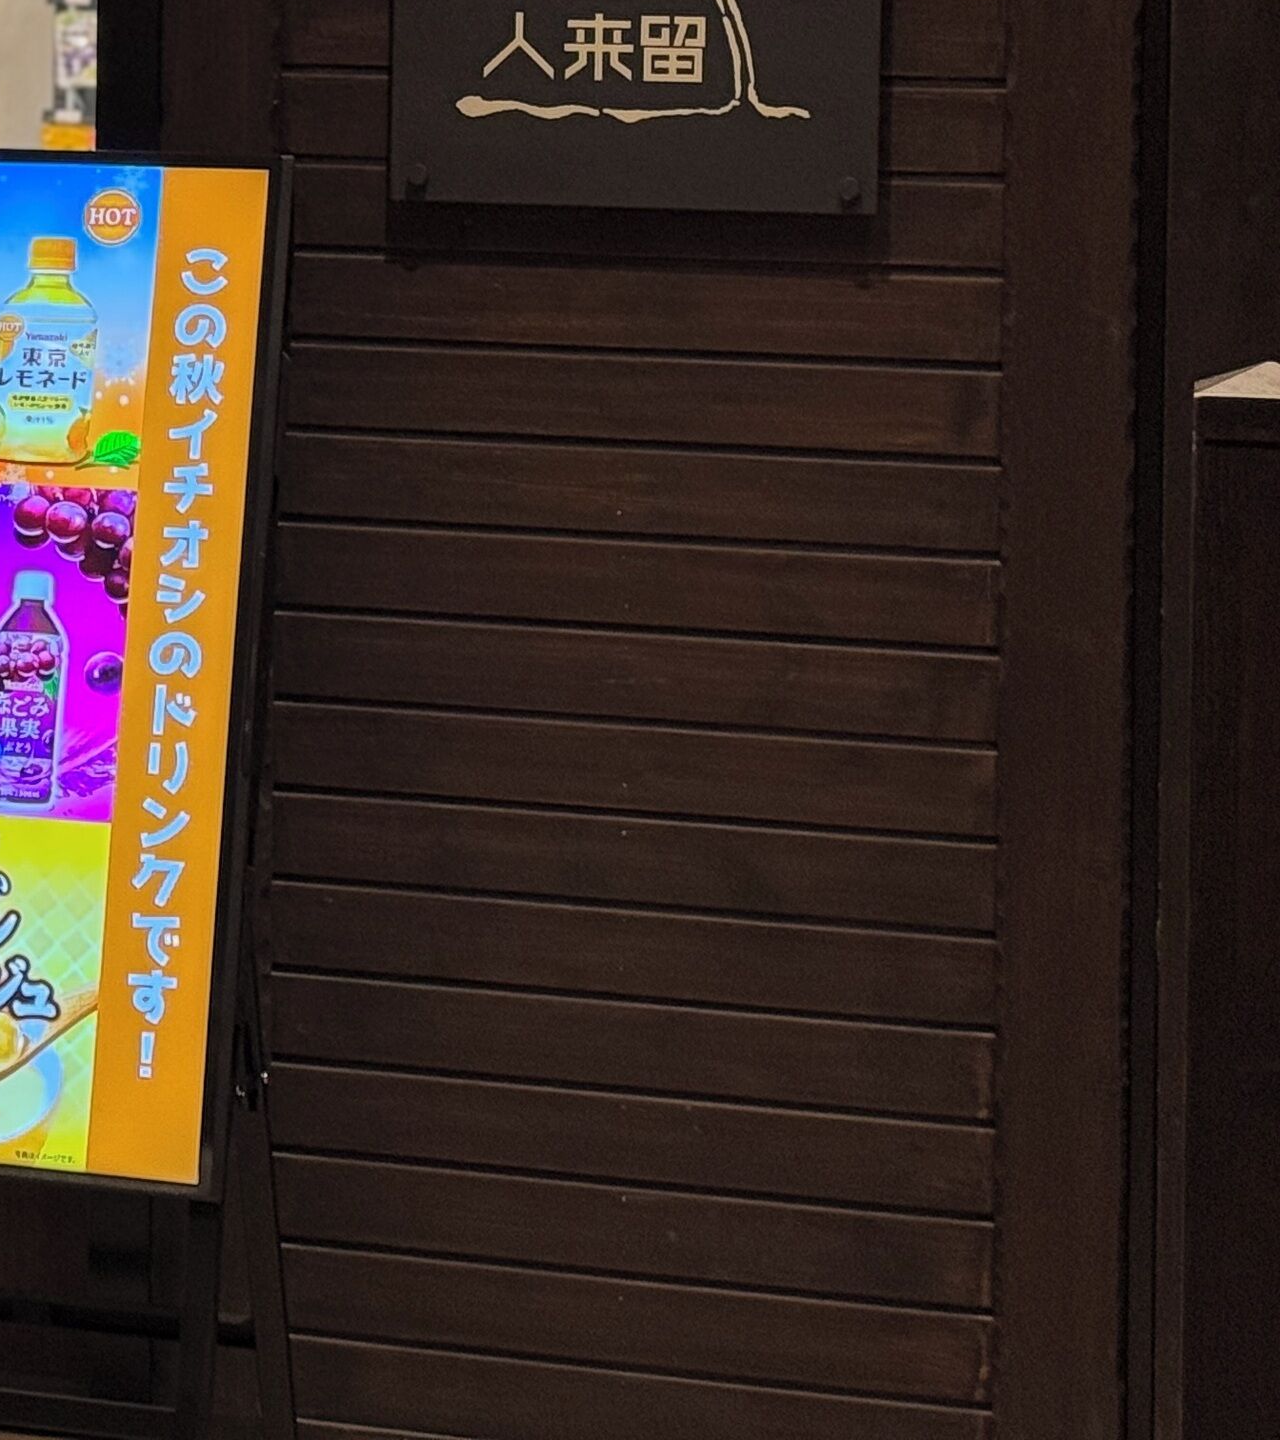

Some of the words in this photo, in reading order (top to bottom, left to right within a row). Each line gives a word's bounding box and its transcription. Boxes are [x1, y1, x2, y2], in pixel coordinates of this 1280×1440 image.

[482, 10, 707, 84] 人来留
[88, 207, 137, 226] HOT
[22, 347, 67, 368] 東京
[127, 247, 228, 1079] この秋イチオシのドリンクです！
